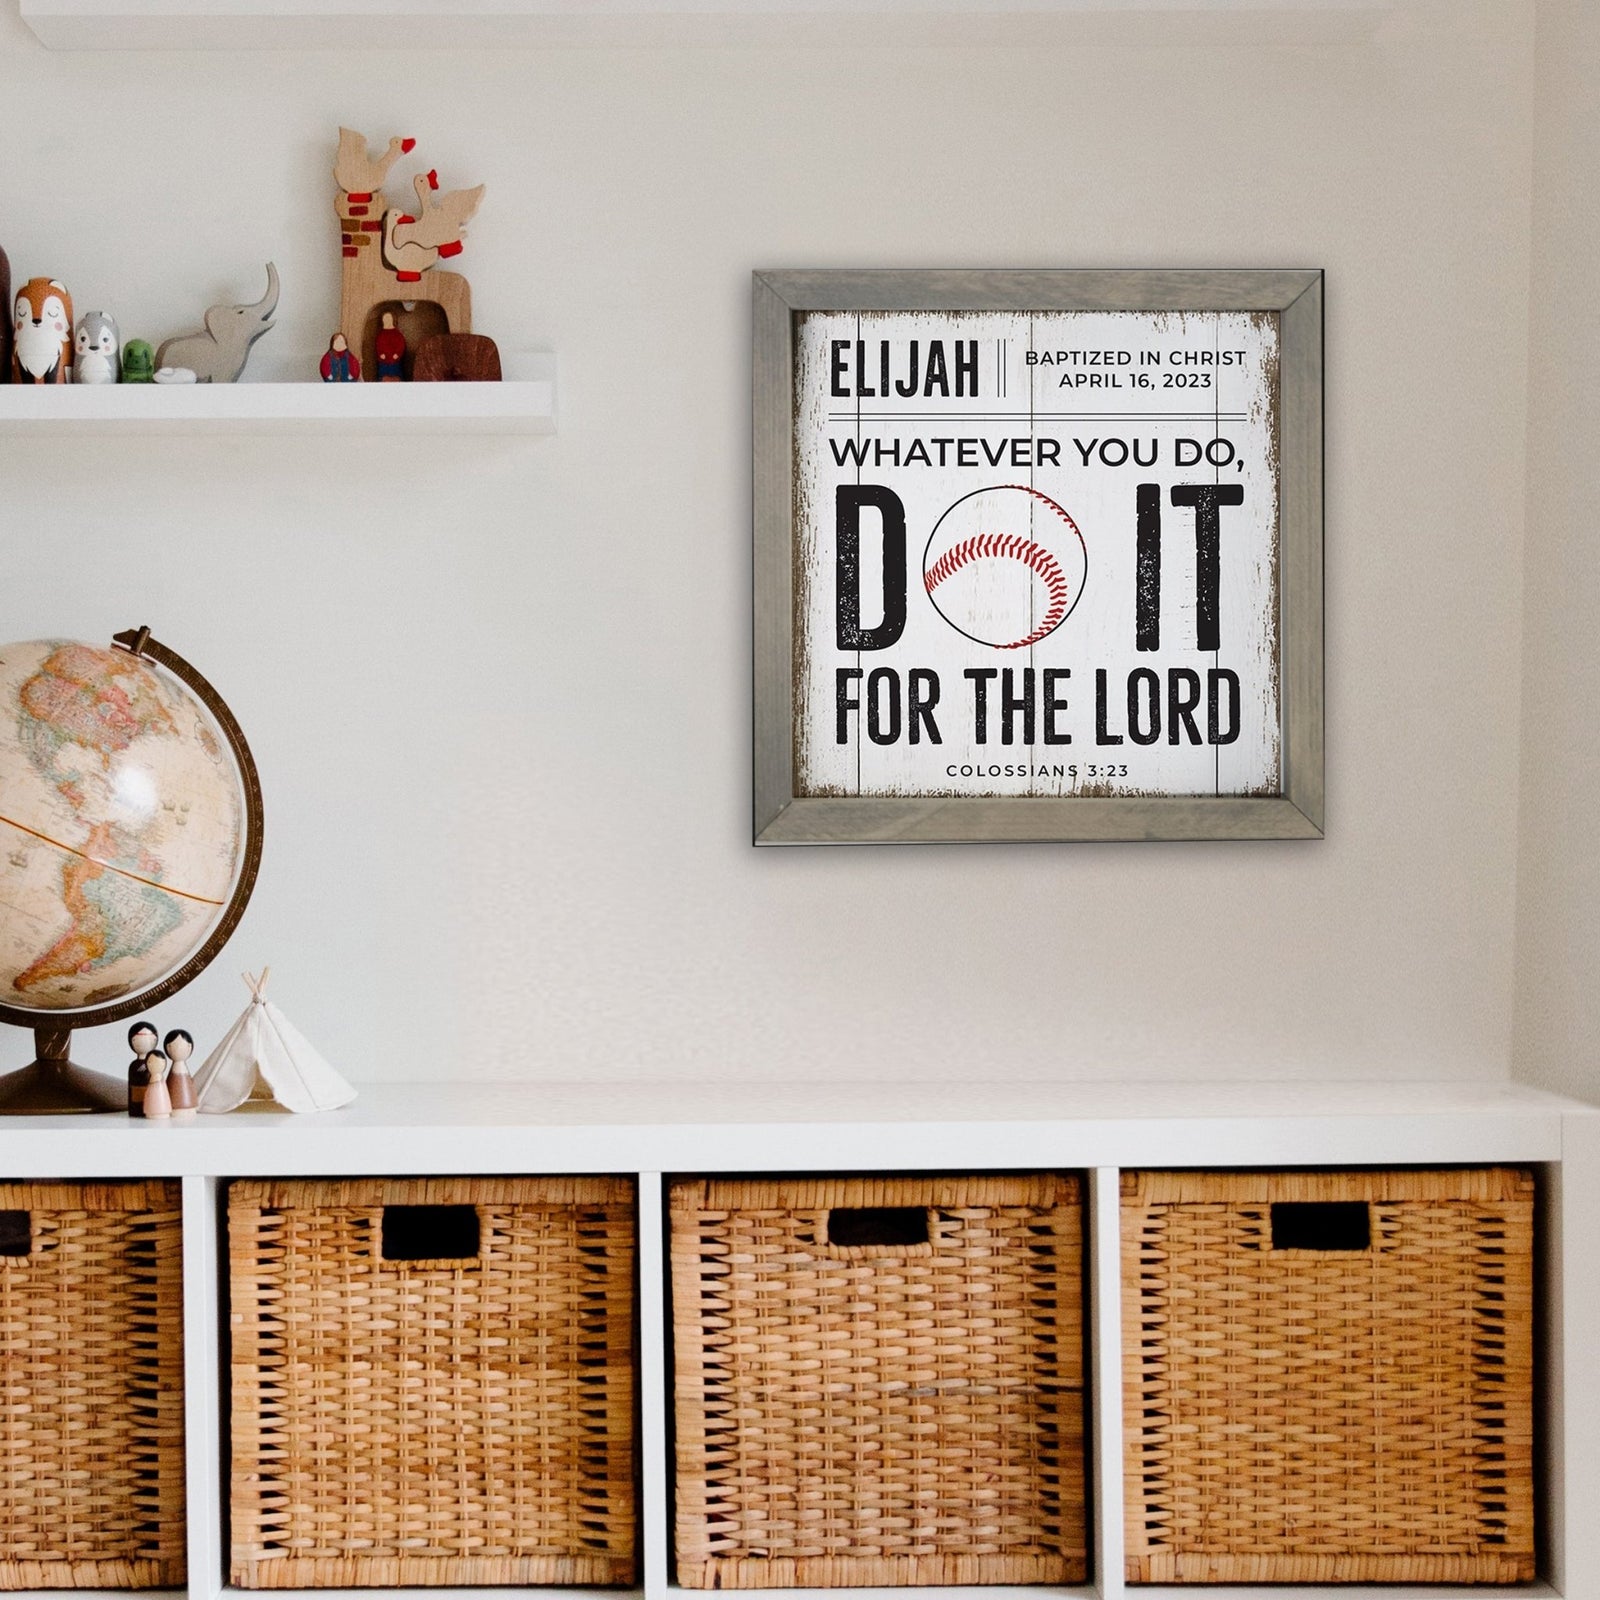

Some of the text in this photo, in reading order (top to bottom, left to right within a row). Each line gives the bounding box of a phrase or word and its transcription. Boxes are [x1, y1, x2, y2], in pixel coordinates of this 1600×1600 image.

[831, 340, 979, 397] ELIJAH
[1026, 351, 1246, 366] BAPTIZED IN CHRIST
[1059, 373, 1212, 390] APRIL 16, 2023
[829, 438, 1244, 473] WHATEVER YOU DO,
[1136, 483, 1244, 652] IT
[836, 667, 1241, 746] FOR THE LORD
[946, 764, 1128, 777] COLOSSIANS 3:23
